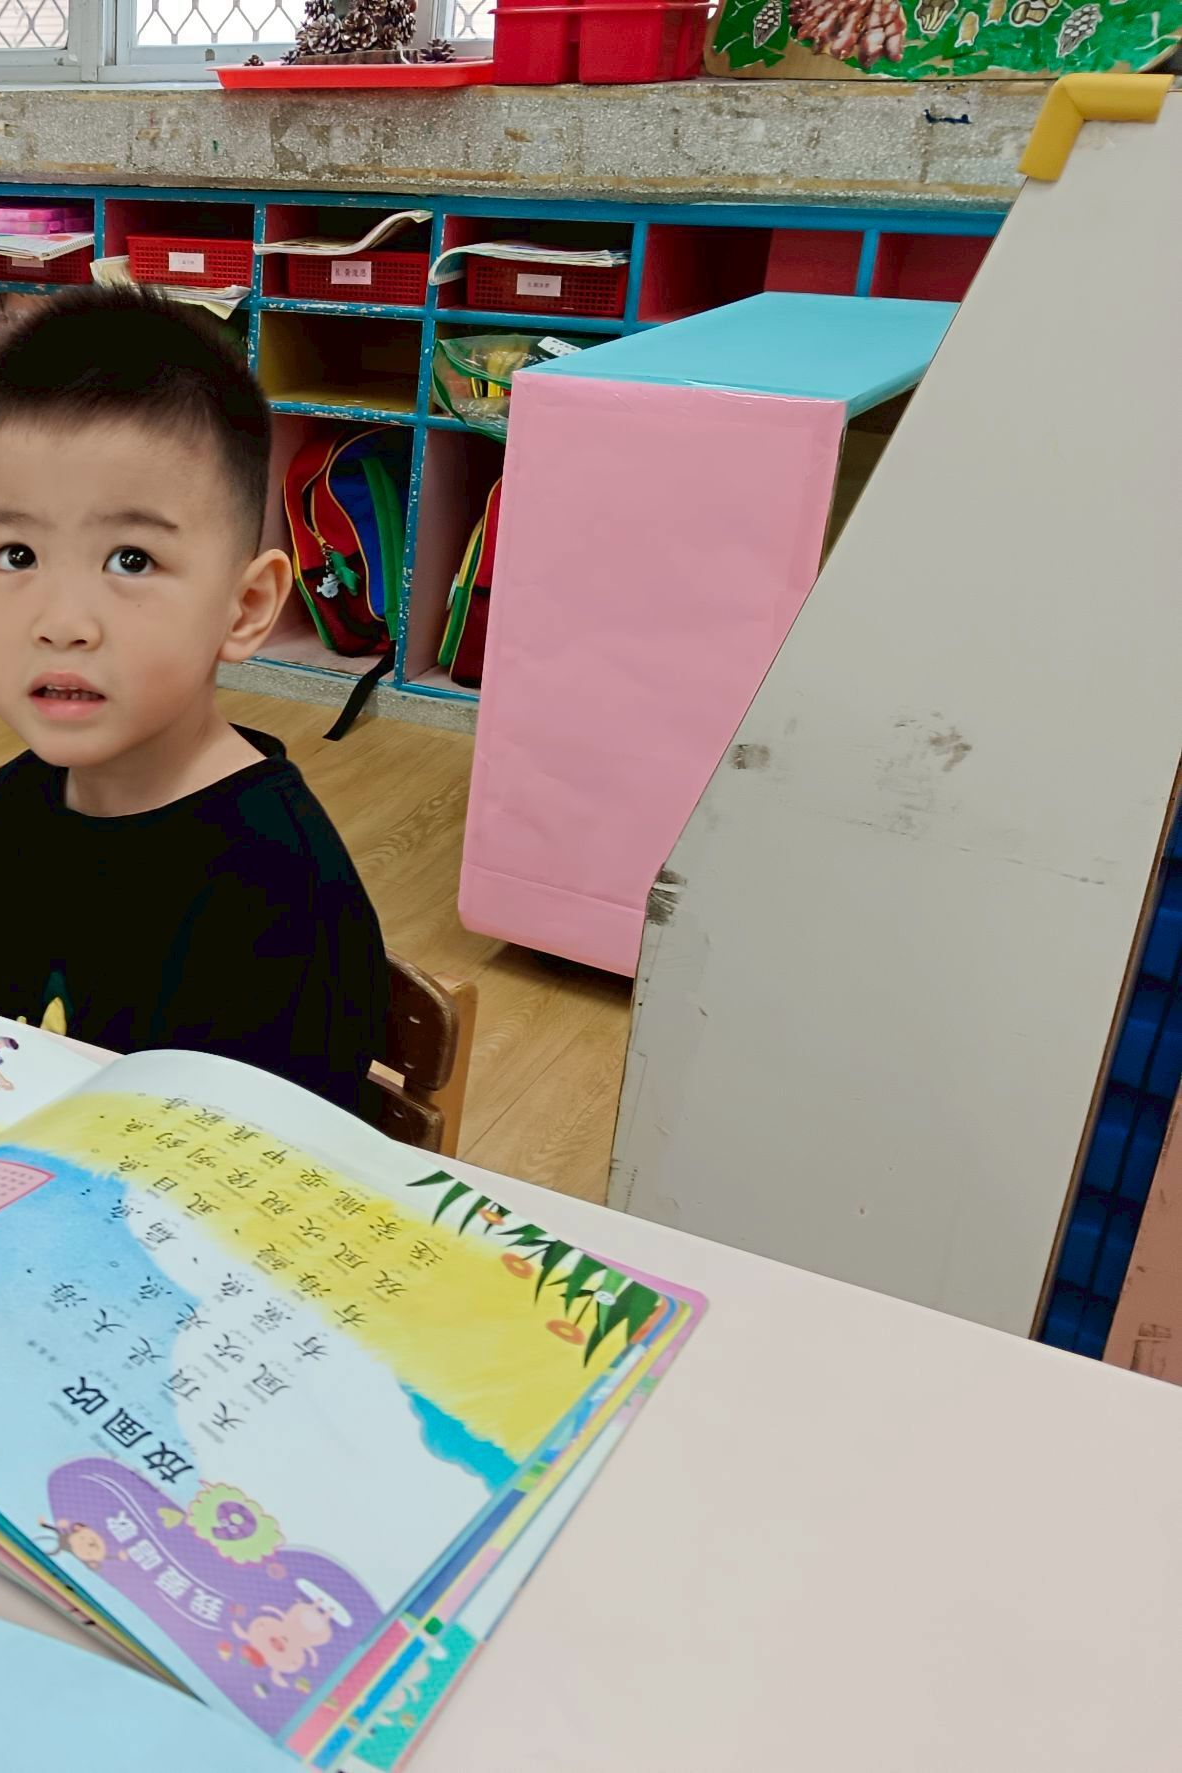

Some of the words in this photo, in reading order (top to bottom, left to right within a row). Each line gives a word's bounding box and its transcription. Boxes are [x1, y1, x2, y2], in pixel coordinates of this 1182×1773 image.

[62, 1376, 194, 1484] 放風吹
[106, 1510, 224, 1623] 我愛唱歌
[211, 1501, 258, 1542] 6
